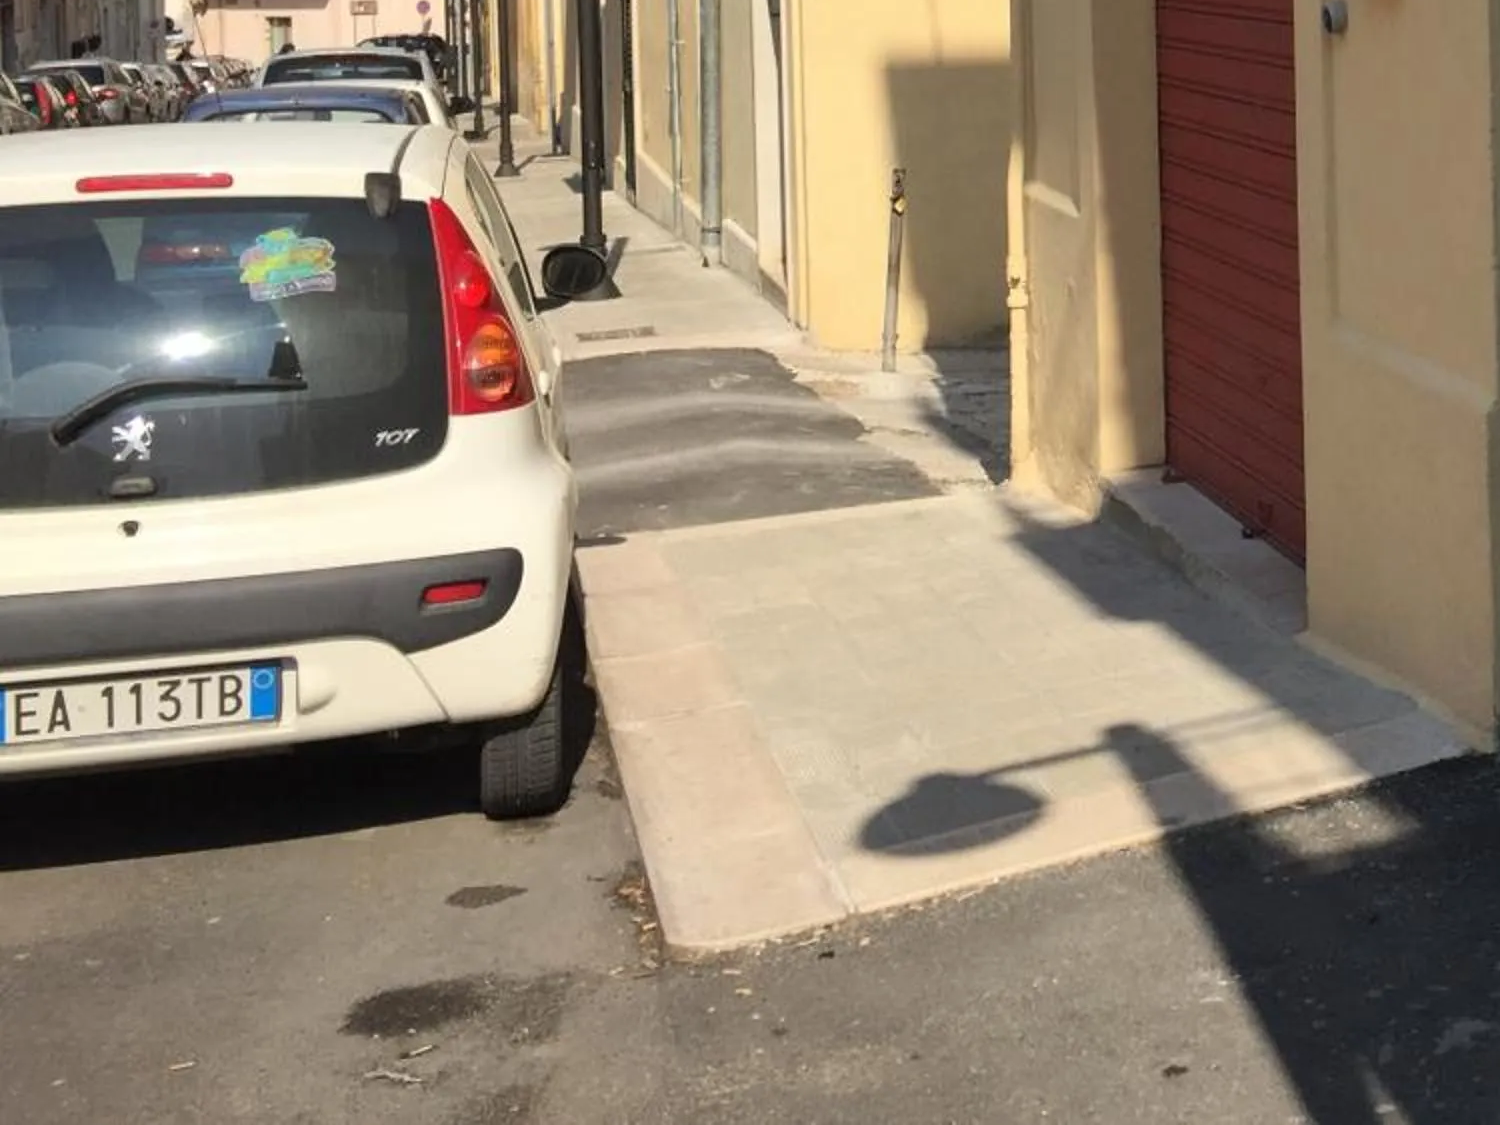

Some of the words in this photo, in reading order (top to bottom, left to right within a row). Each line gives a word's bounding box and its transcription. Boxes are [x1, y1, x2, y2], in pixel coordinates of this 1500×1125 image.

[375, 428, 420, 447] 107
[14, 689, 71, 736] EA
[101, 674, 243, 728] 113TB
